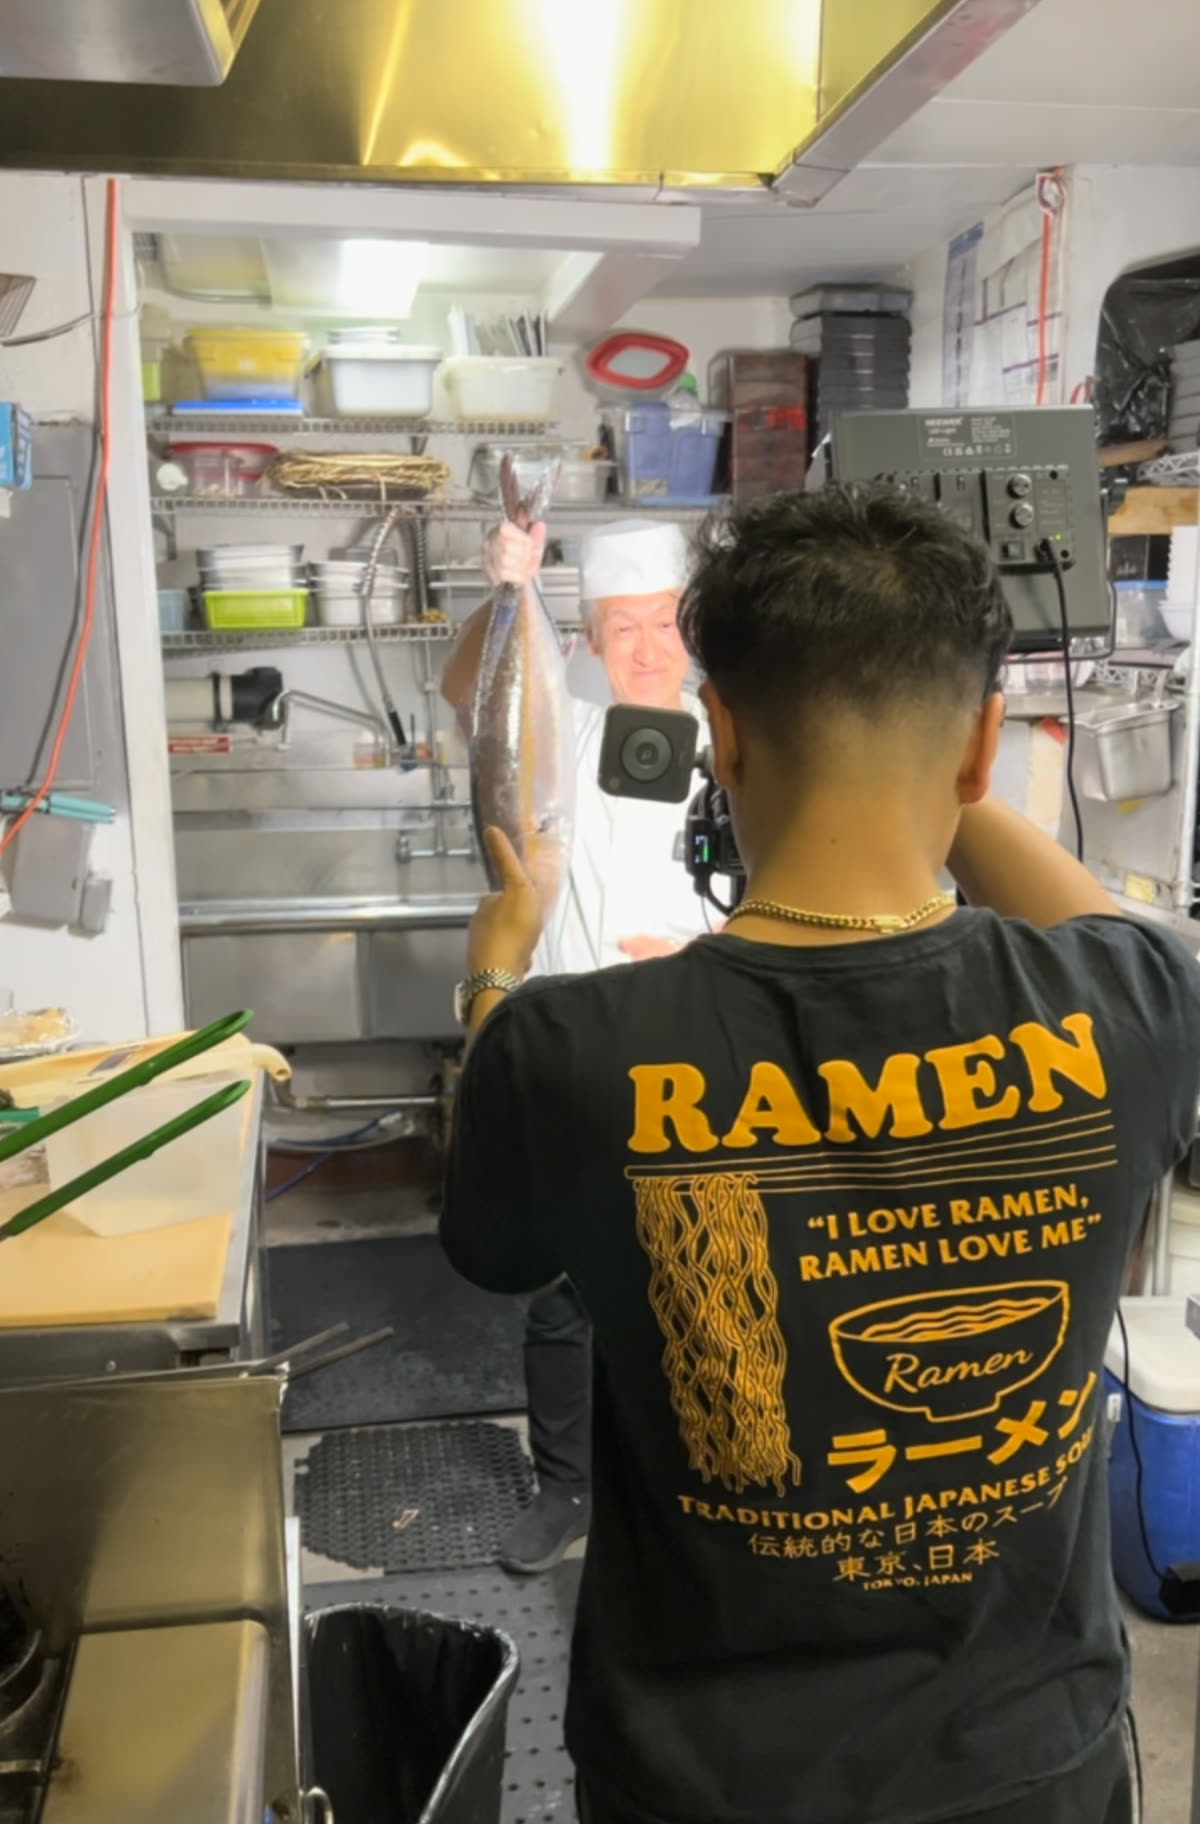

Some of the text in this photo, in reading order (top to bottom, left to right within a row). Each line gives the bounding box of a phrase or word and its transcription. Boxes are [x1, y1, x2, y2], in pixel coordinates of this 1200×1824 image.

[627, 1010, 1108, 1154] RAMEN
[848, 1203, 941, 1237] LOVE
[948, 1183, 1090, 1226] RAMEN,
[799, 1212, 1103, 1282] RAMEN LOVE ME”
[883, 1348, 1034, 1394] Ramen
[826, 1371, 1098, 1495] ラーメン
[677, 1495, 896, 1531] TRADITIONAL
[903, 1466, 1052, 1521] JAPANESE
[832, 1537, 1000, 1582] 東京、日本
[923, 1572, 973, 1588] JAPAN
